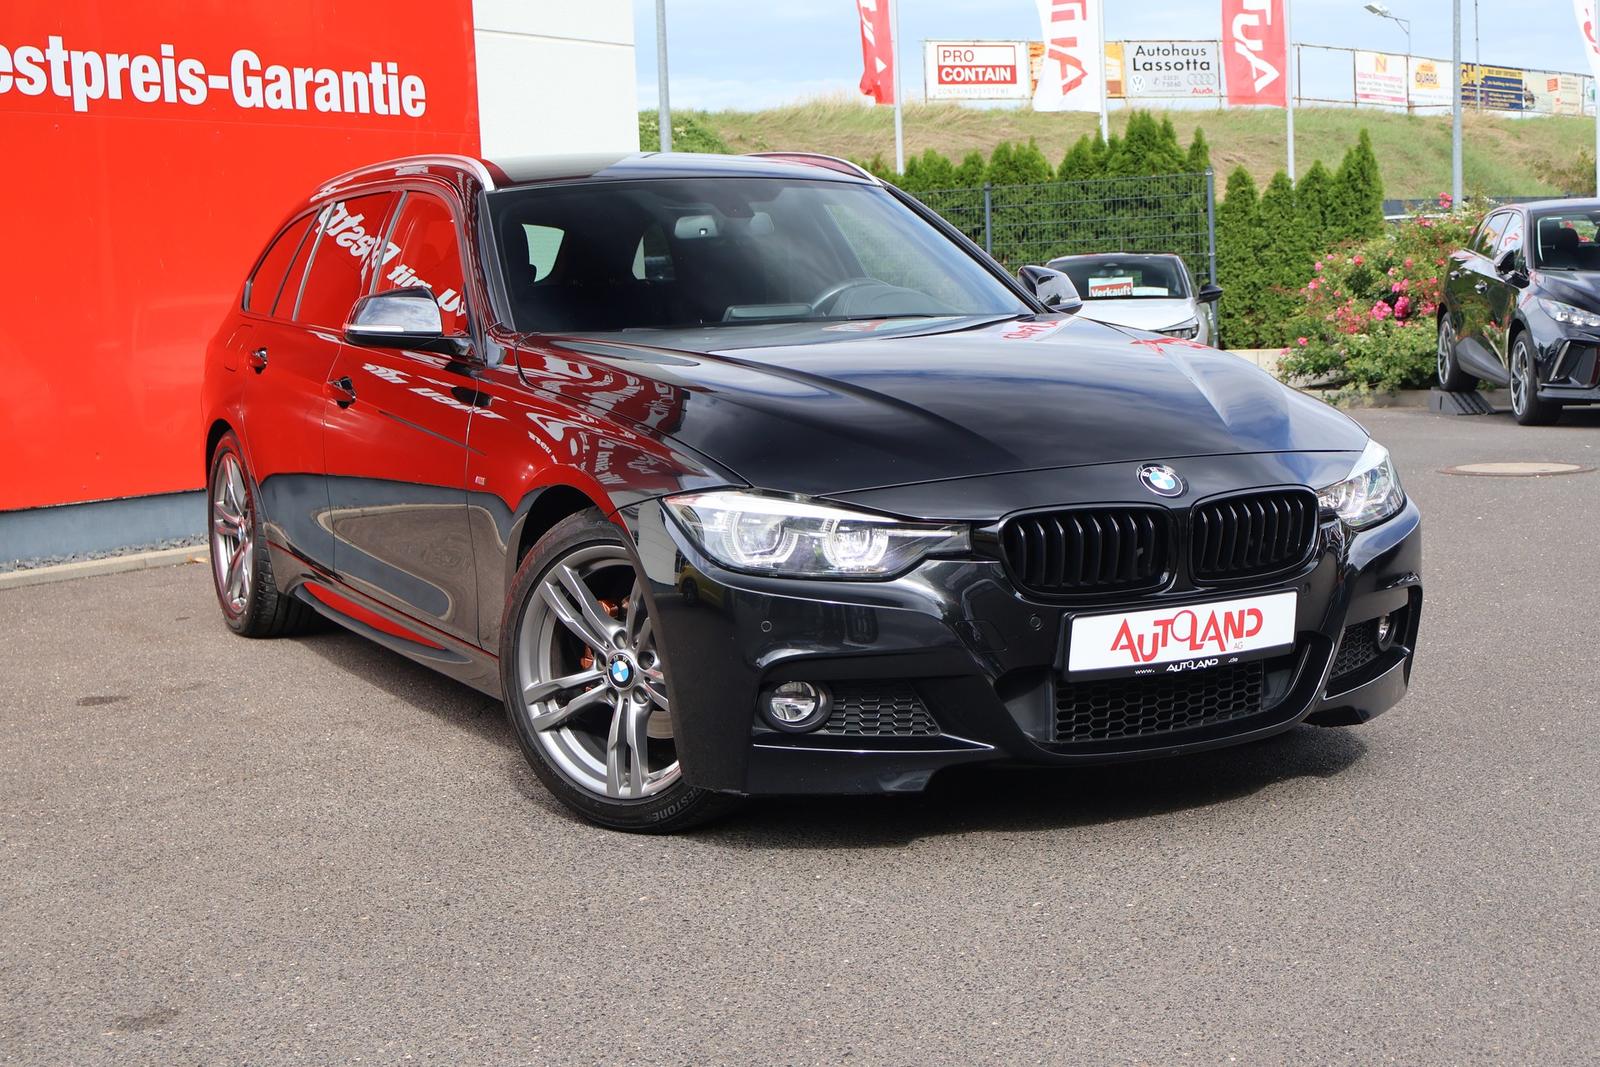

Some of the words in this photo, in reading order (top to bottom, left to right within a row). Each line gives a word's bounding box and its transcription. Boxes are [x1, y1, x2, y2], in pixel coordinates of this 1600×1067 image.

[942, 49, 975, 62] PRO
[1135, 44, 1207, 57] Autohaus
[1132, 57, 1211, 72] Lassotta
[941, 66, 1012, 82] CONTAIN
[1191, 87, 1215, 95] Audi
[1091, 284, 1132, 297] Verkauft
[1110, 607, 1264, 663] AUTOLAND
[1233, 641, 1244, 650] AG
[1166, 658, 1219, 673] AUTOLAND
